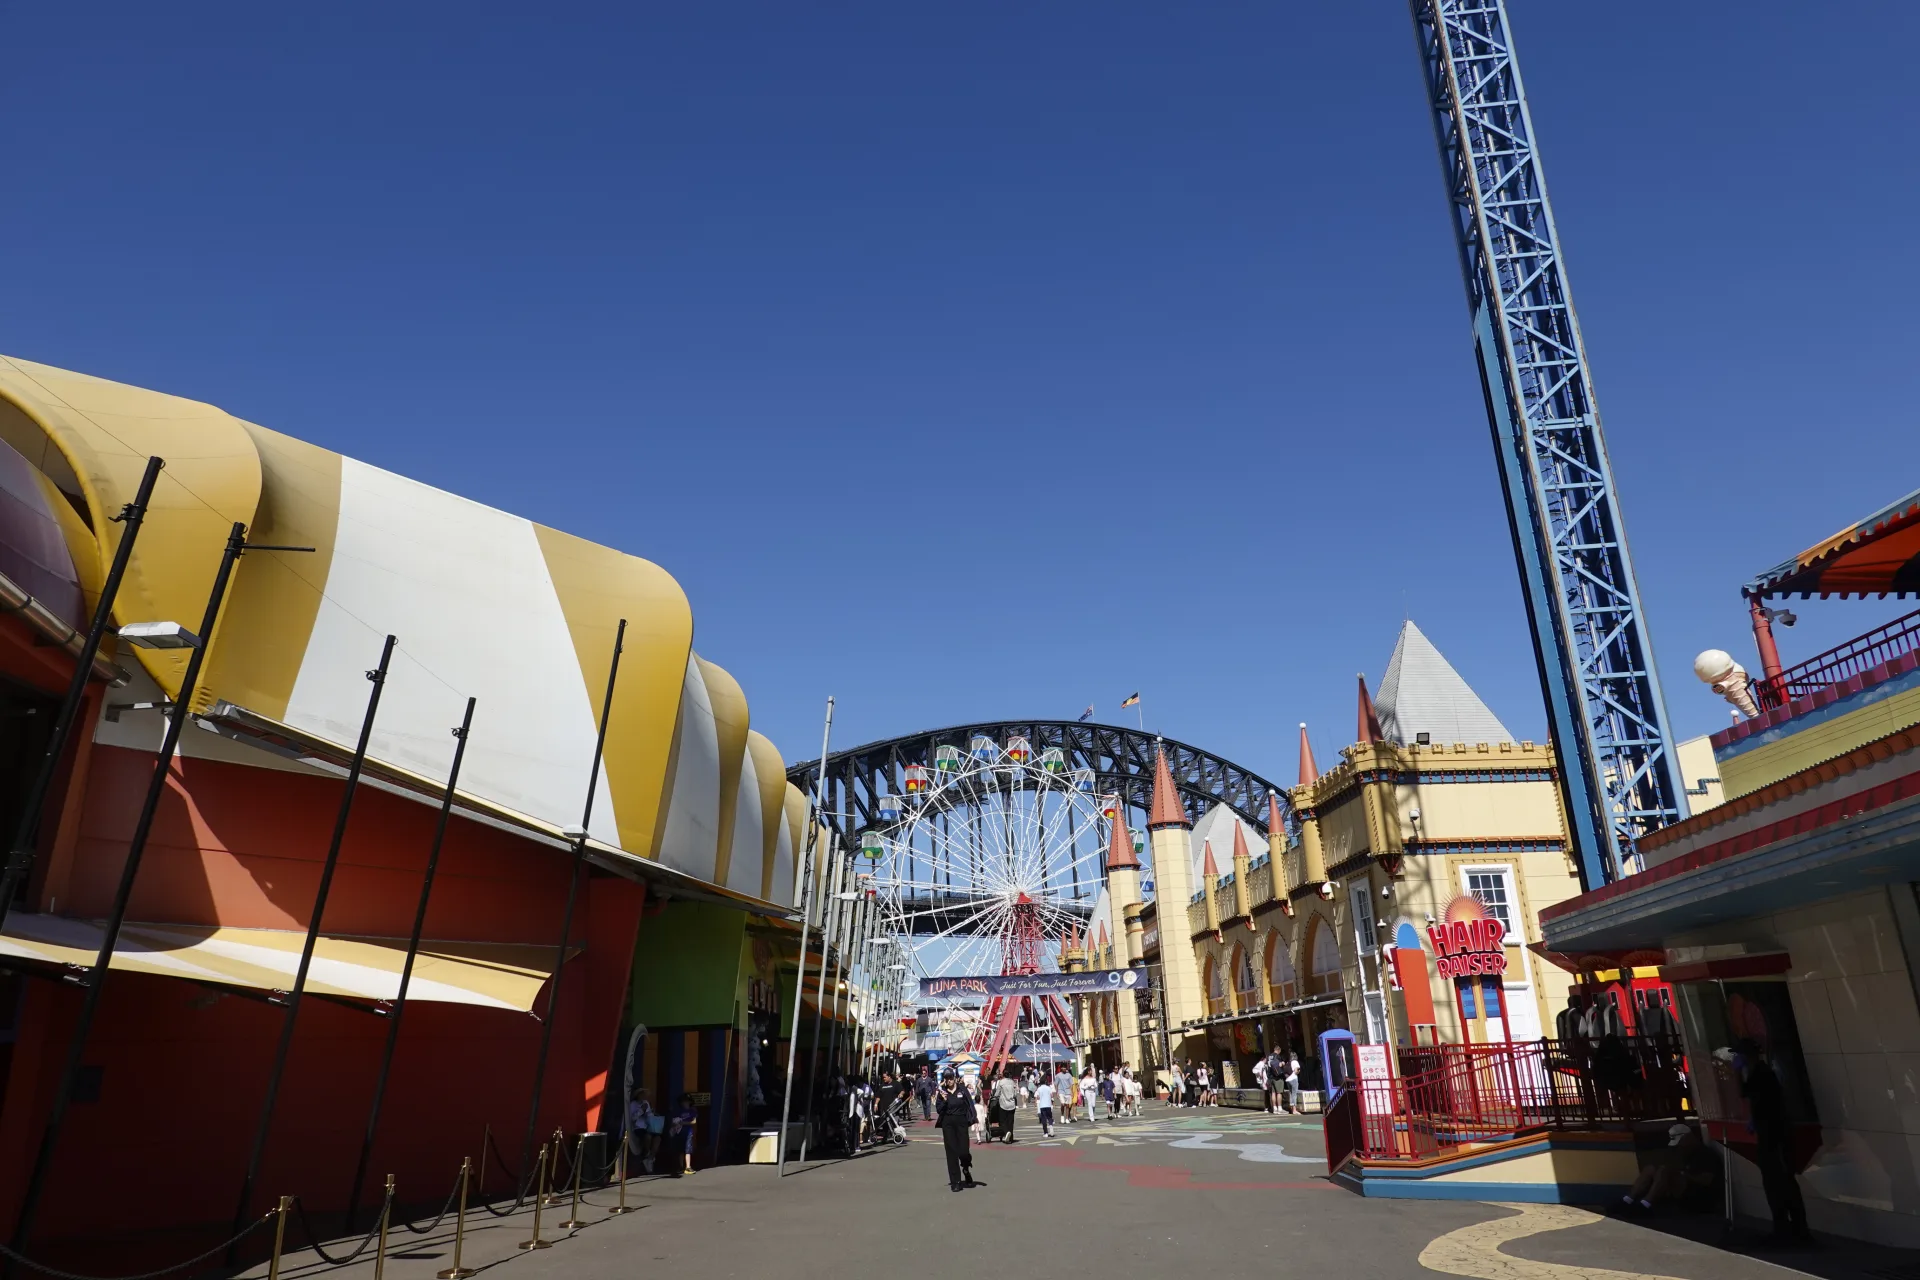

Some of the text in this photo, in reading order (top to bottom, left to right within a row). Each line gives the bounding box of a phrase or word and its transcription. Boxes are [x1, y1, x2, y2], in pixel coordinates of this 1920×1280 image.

[1427, 918, 1507, 958] HAIR
[1436, 953, 1507, 980] RAISER
[929, 979, 989, 995] LUNA PARK
[1017, 980, 1032, 989] For
[1068, 977, 1096, 987] Forever
